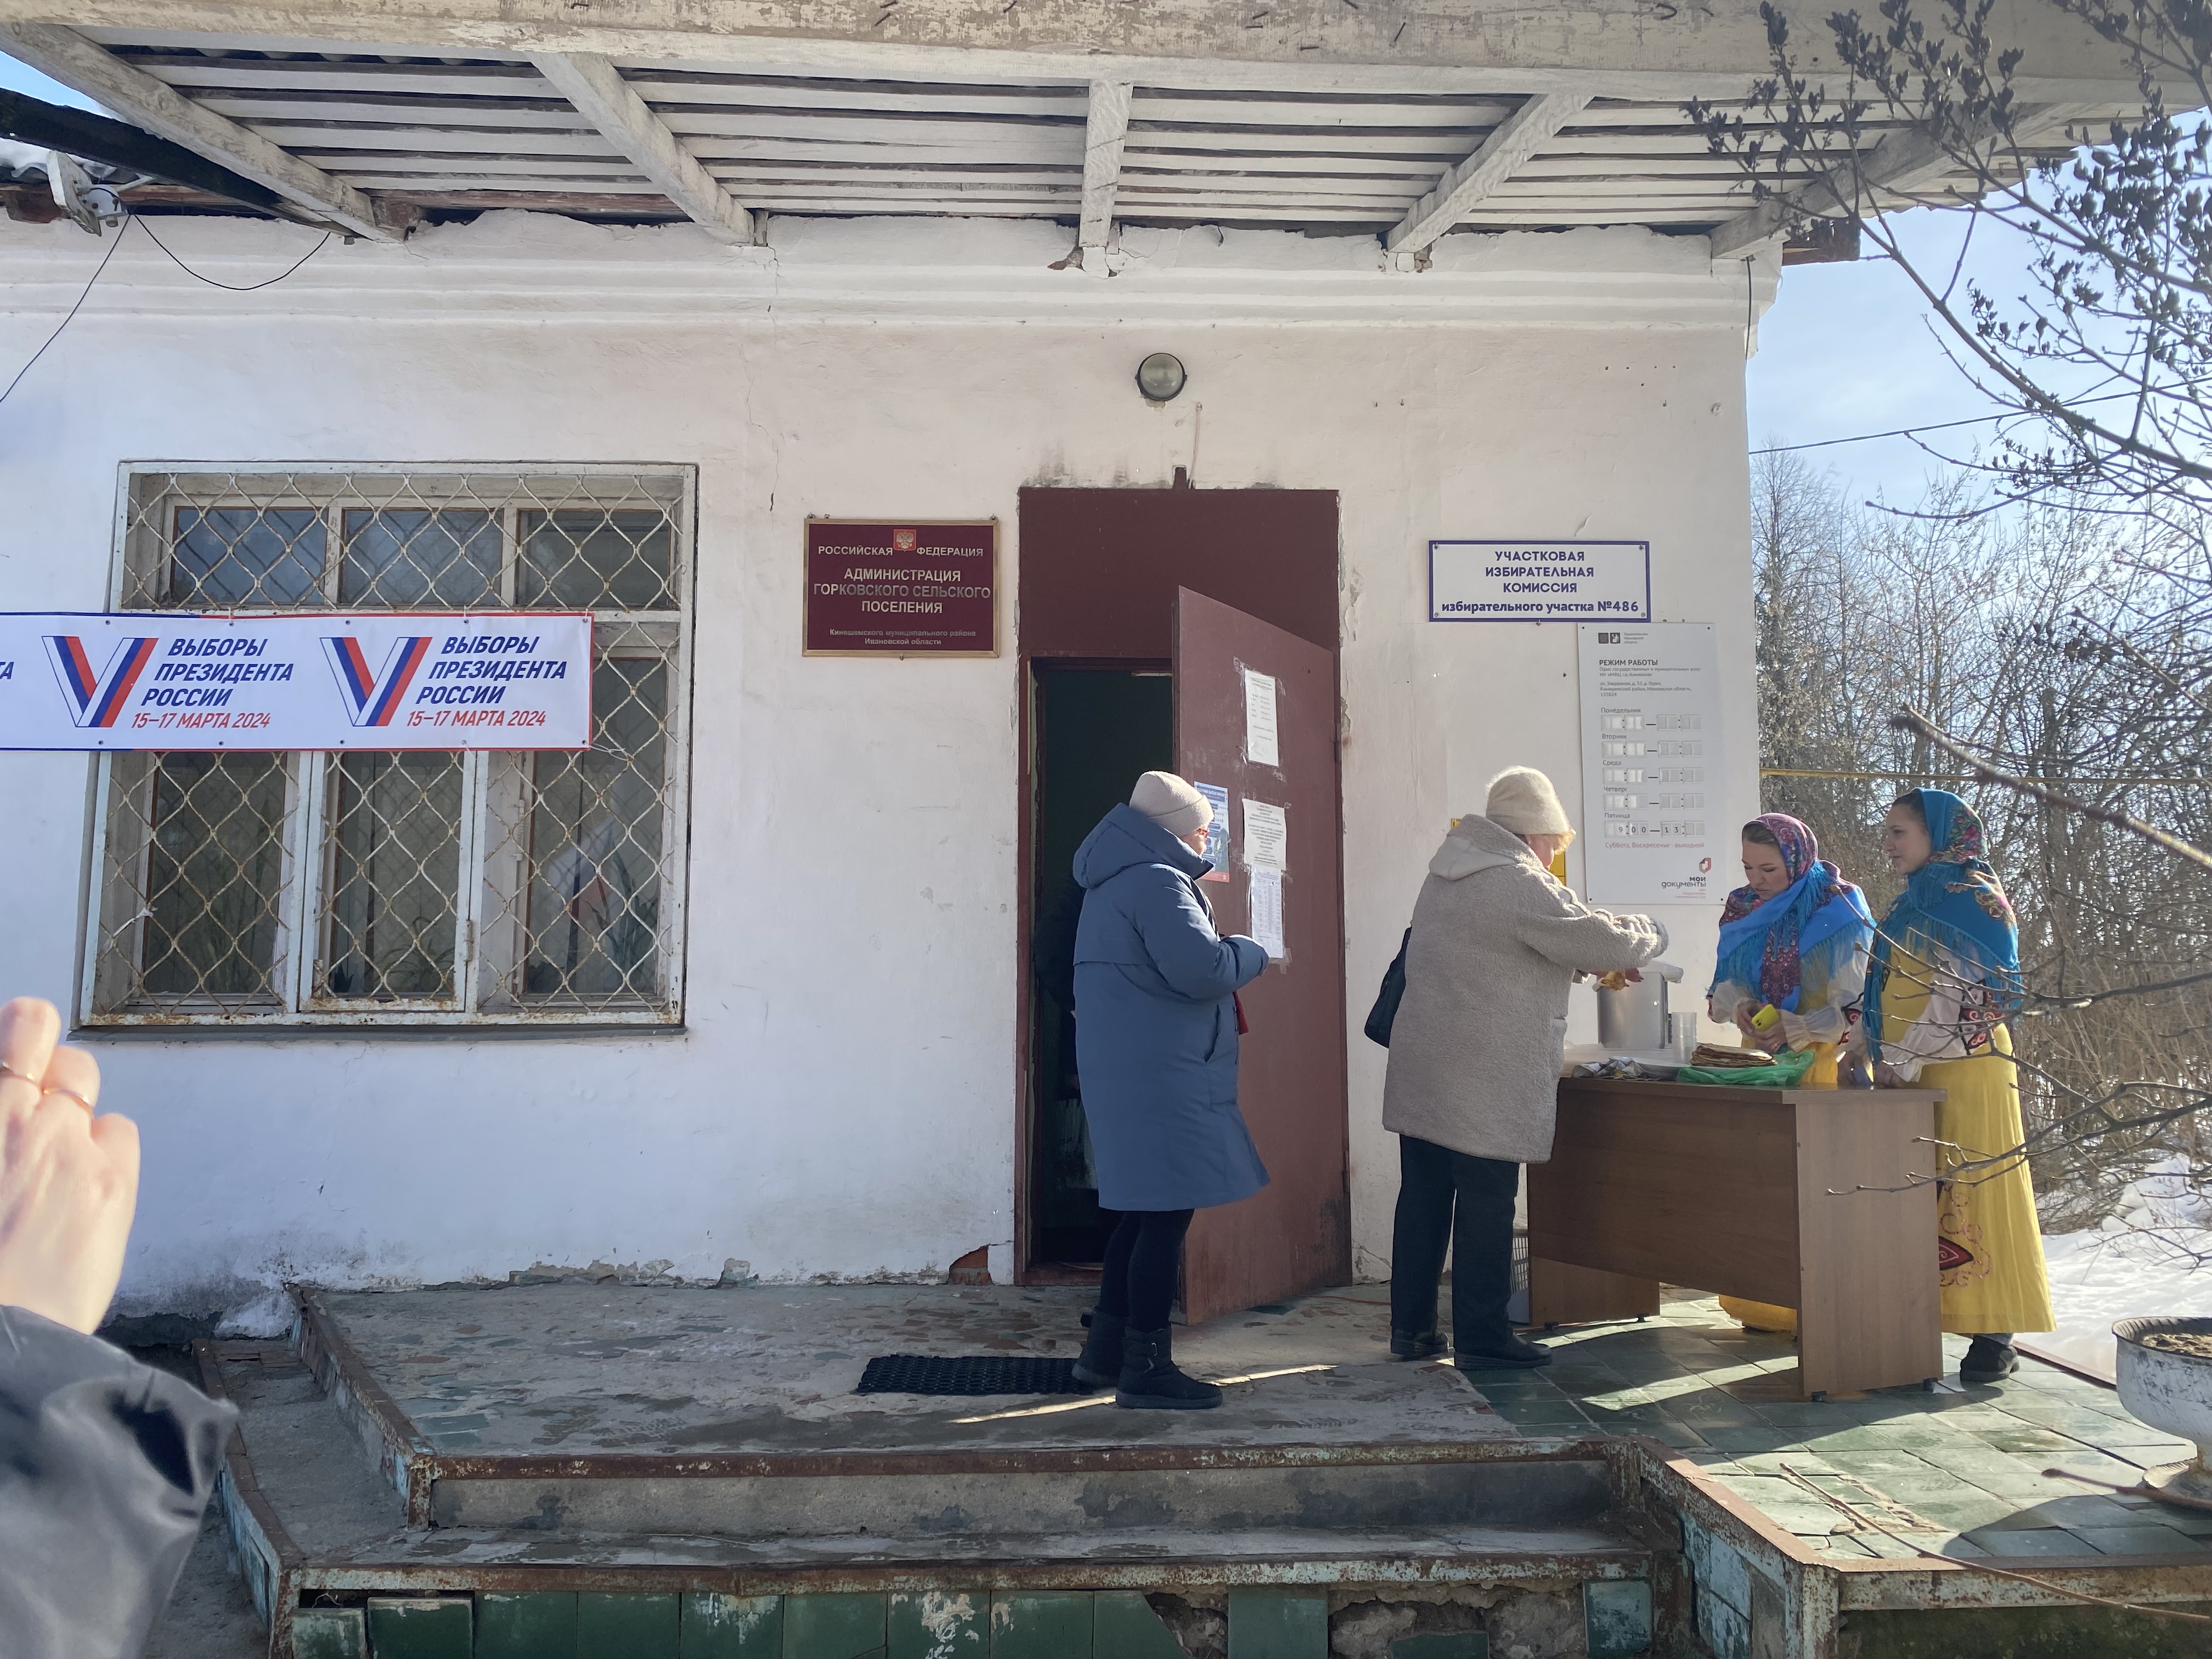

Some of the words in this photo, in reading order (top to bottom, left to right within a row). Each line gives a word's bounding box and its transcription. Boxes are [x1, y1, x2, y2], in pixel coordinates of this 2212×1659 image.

[818, 545, 893, 556] РОССИЙСКАЯ
[916, 546, 984, 558] ФЕДЕРАЦИЯ
[1494, 551, 1585, 562] УЧАСТКОВАЯ
[844, 568, 961, 583] АДМИНИСТРАЦИЯ
[1486, 567, 1594, 577] ИЗБИРАТЕЛЬНАЯ
[814, 583, 909, 597] ГОРКОВСКОГО
[912, 585, 991, 599] СЕЛЬСКОГО
[1503, 582, 1577, 593] КОМИССИЯ
[861, 600, 943, 614] ПОСЕЛЕНИЯ
[1441, 601, 1543, 613] избирательного
[1546, 602, 1594, 614] участка
[1597, 601, 1639, 612] №486
[830, 629, 883, 637] Кинешемского
[167, 638, 269, 656] ВЫБОРЫ
[441, 636, 540, 654] ВЫБОРЫ
[154, 663, 294, 684] ПРЕЗИДЕНТА
[428, 661, 567, 681] ПРЕЗИДЕНТА
[141, 689, 233, 707] РОССИИ
[415, 686, 507, 704] РОССИИ
[176, 713, 230, 728] МАРТА
[232, 713, 272, 728] 2024
[451, 710, 505, 726] МАРТА
[507, 710, 546, 726] 2024
